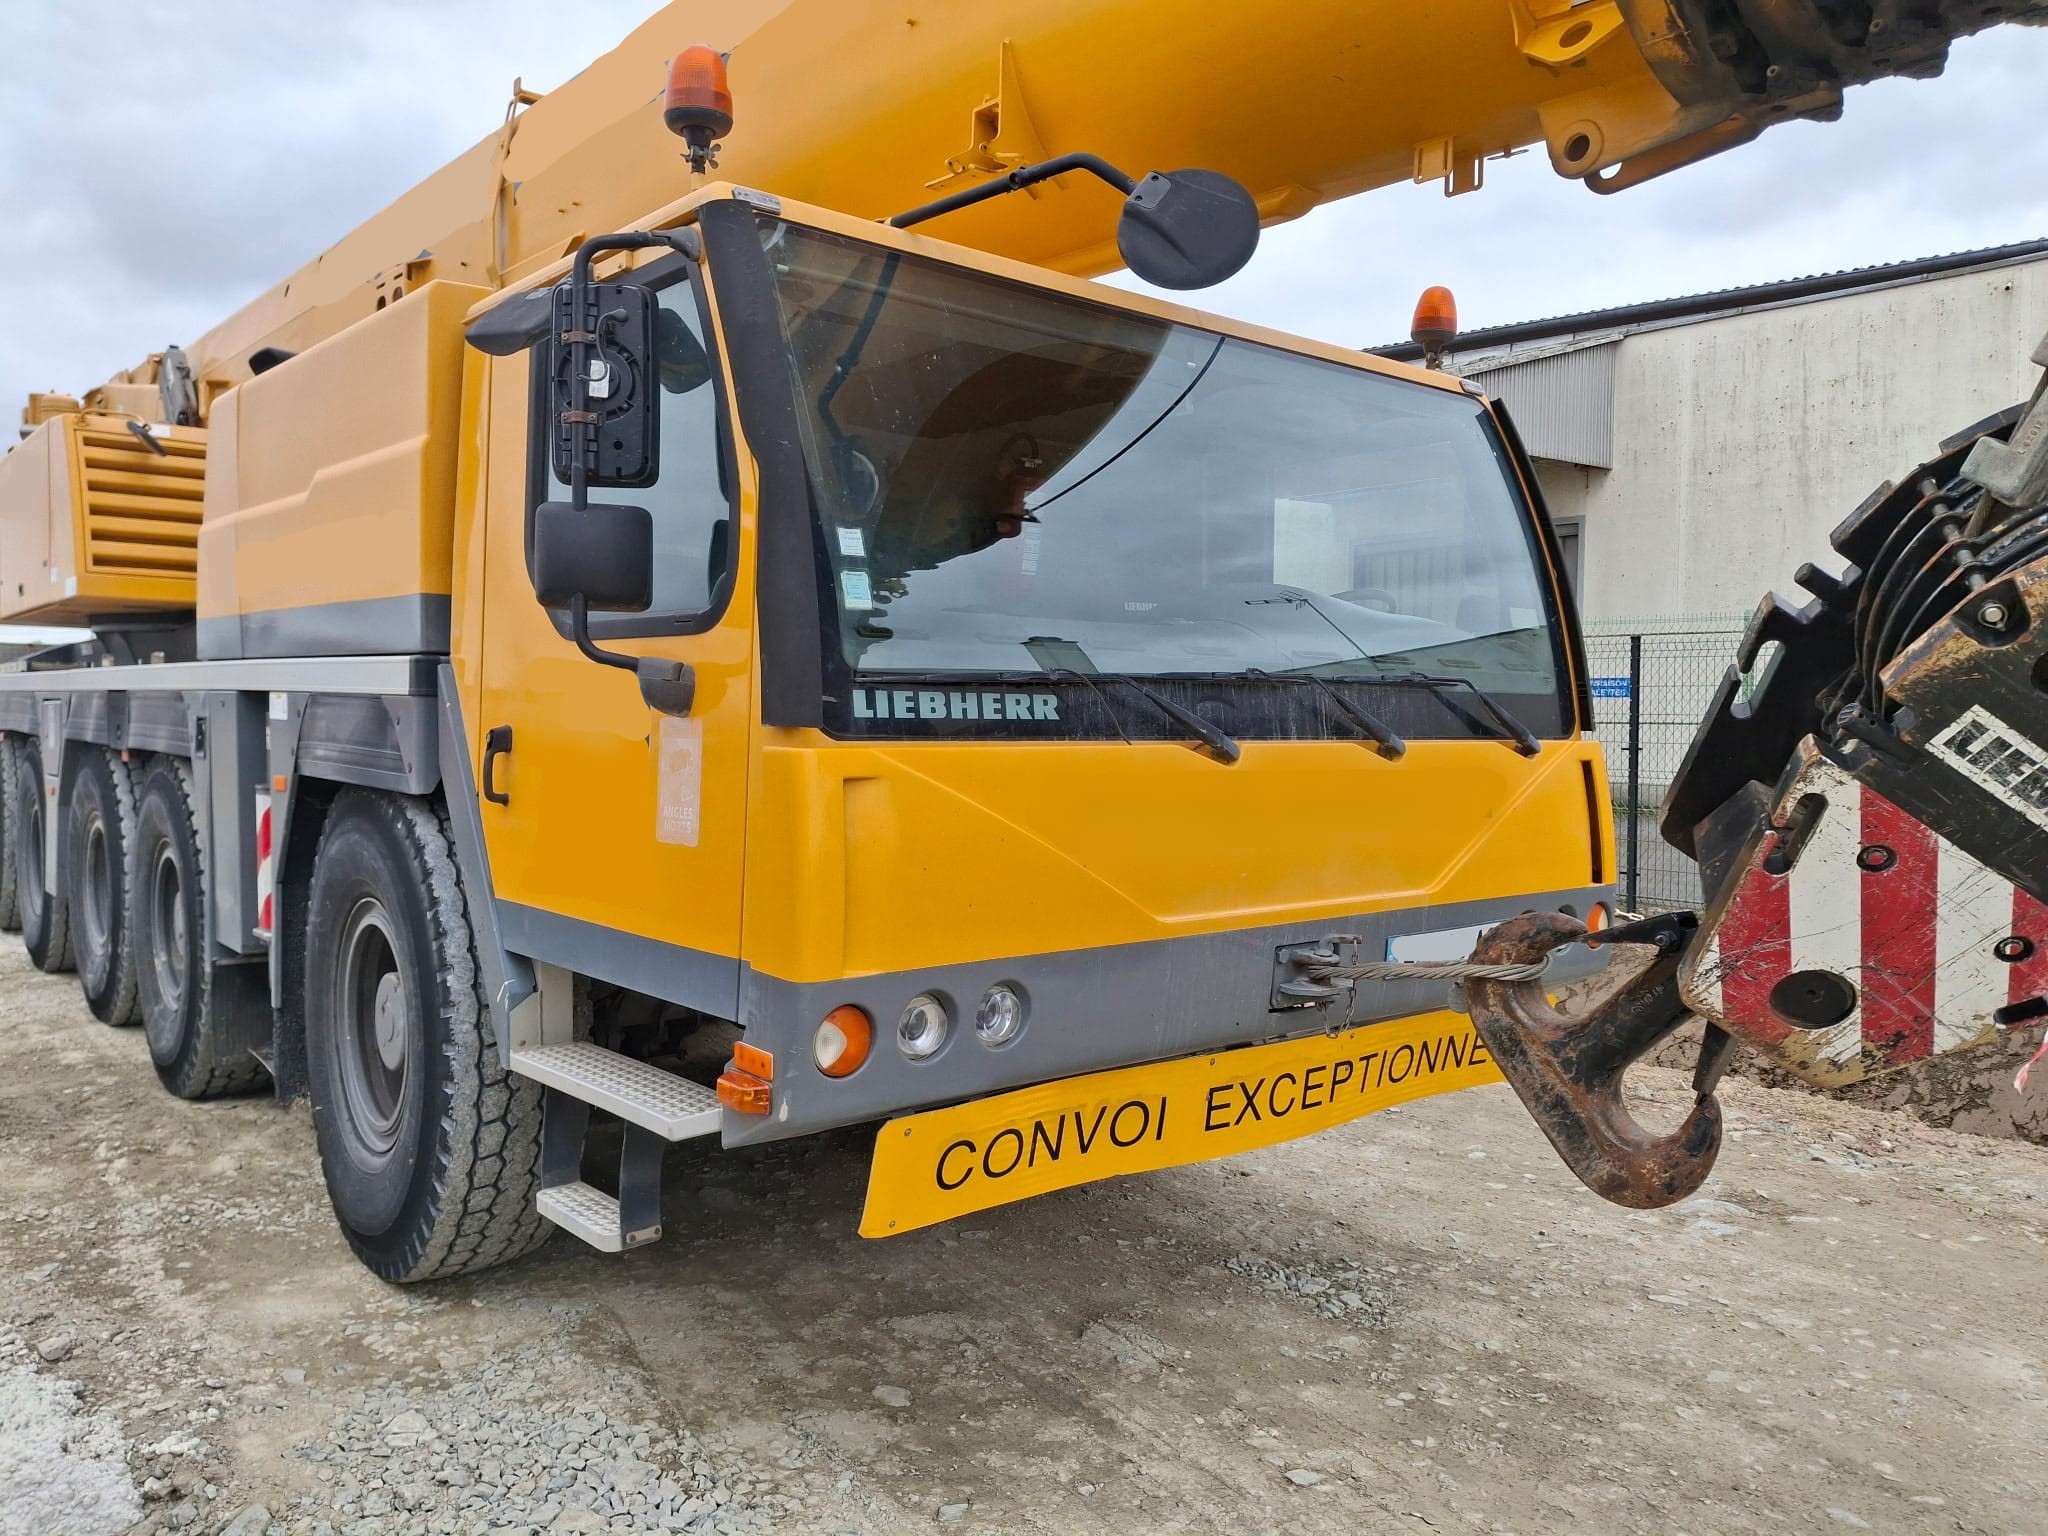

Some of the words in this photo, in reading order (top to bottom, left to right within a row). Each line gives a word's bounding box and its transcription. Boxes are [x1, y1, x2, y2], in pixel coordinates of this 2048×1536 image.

[853, 689, 1060, 721] LIEBHERR
[663, 805, 694, 819] ANGLES
[936, 1096, 1167, 1191] CONVOI
[1204, 1032, 1494, 1132] EXCEPTIONNE
